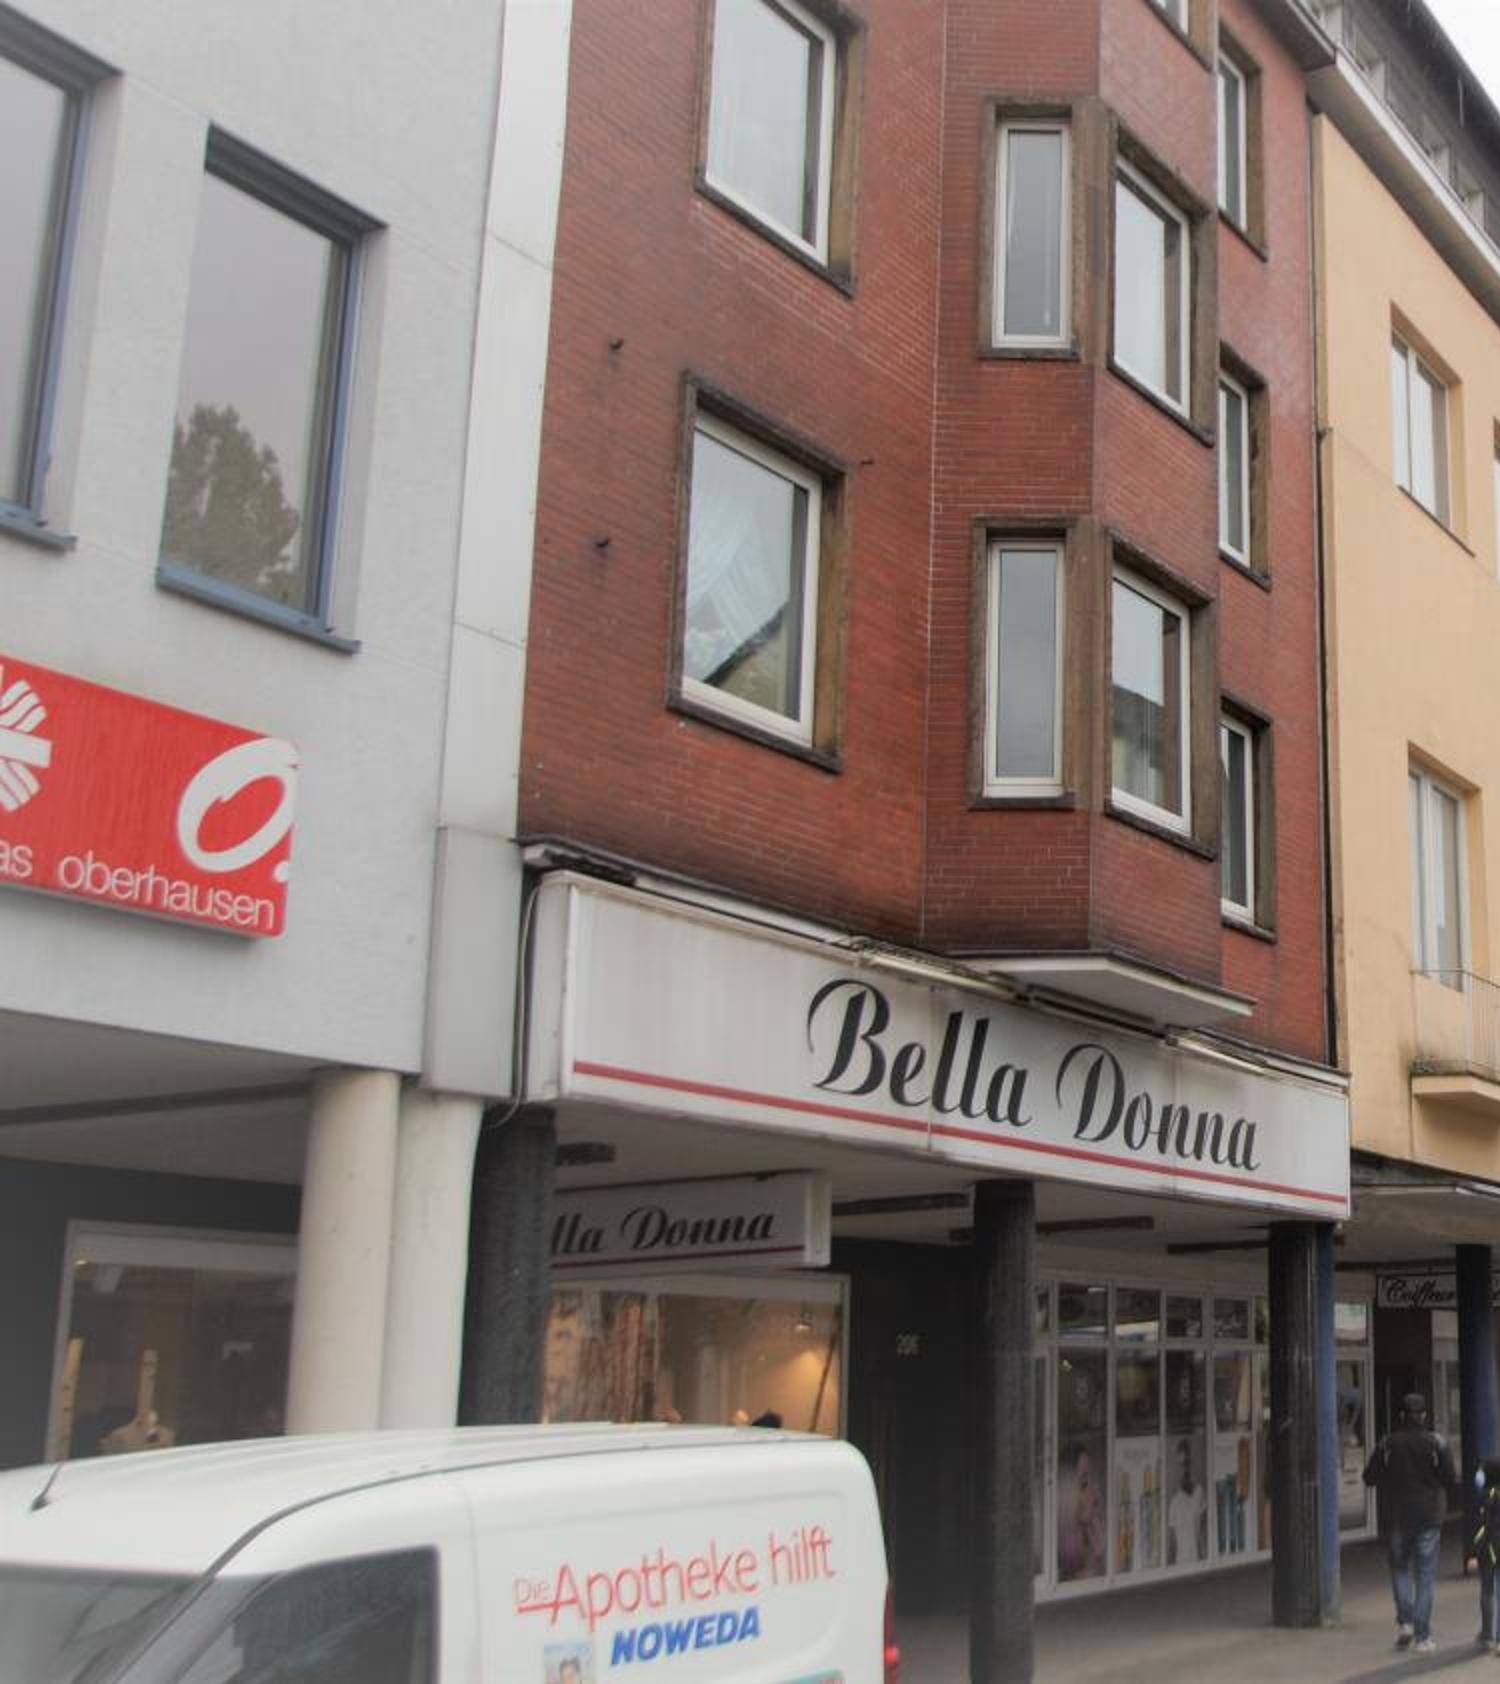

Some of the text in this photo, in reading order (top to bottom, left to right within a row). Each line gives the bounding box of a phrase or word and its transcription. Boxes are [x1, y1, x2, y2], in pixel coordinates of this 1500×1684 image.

[58, 851, 275, 928] oberhausen
[806, 978, 1260, 1171] Bella Donna
[549, 1205, 776, 1255] lla Donna
[512, 1524, 836, 1632] Die Apotheke hilft
[610, 1605, 763, 1668] NOWEDA
